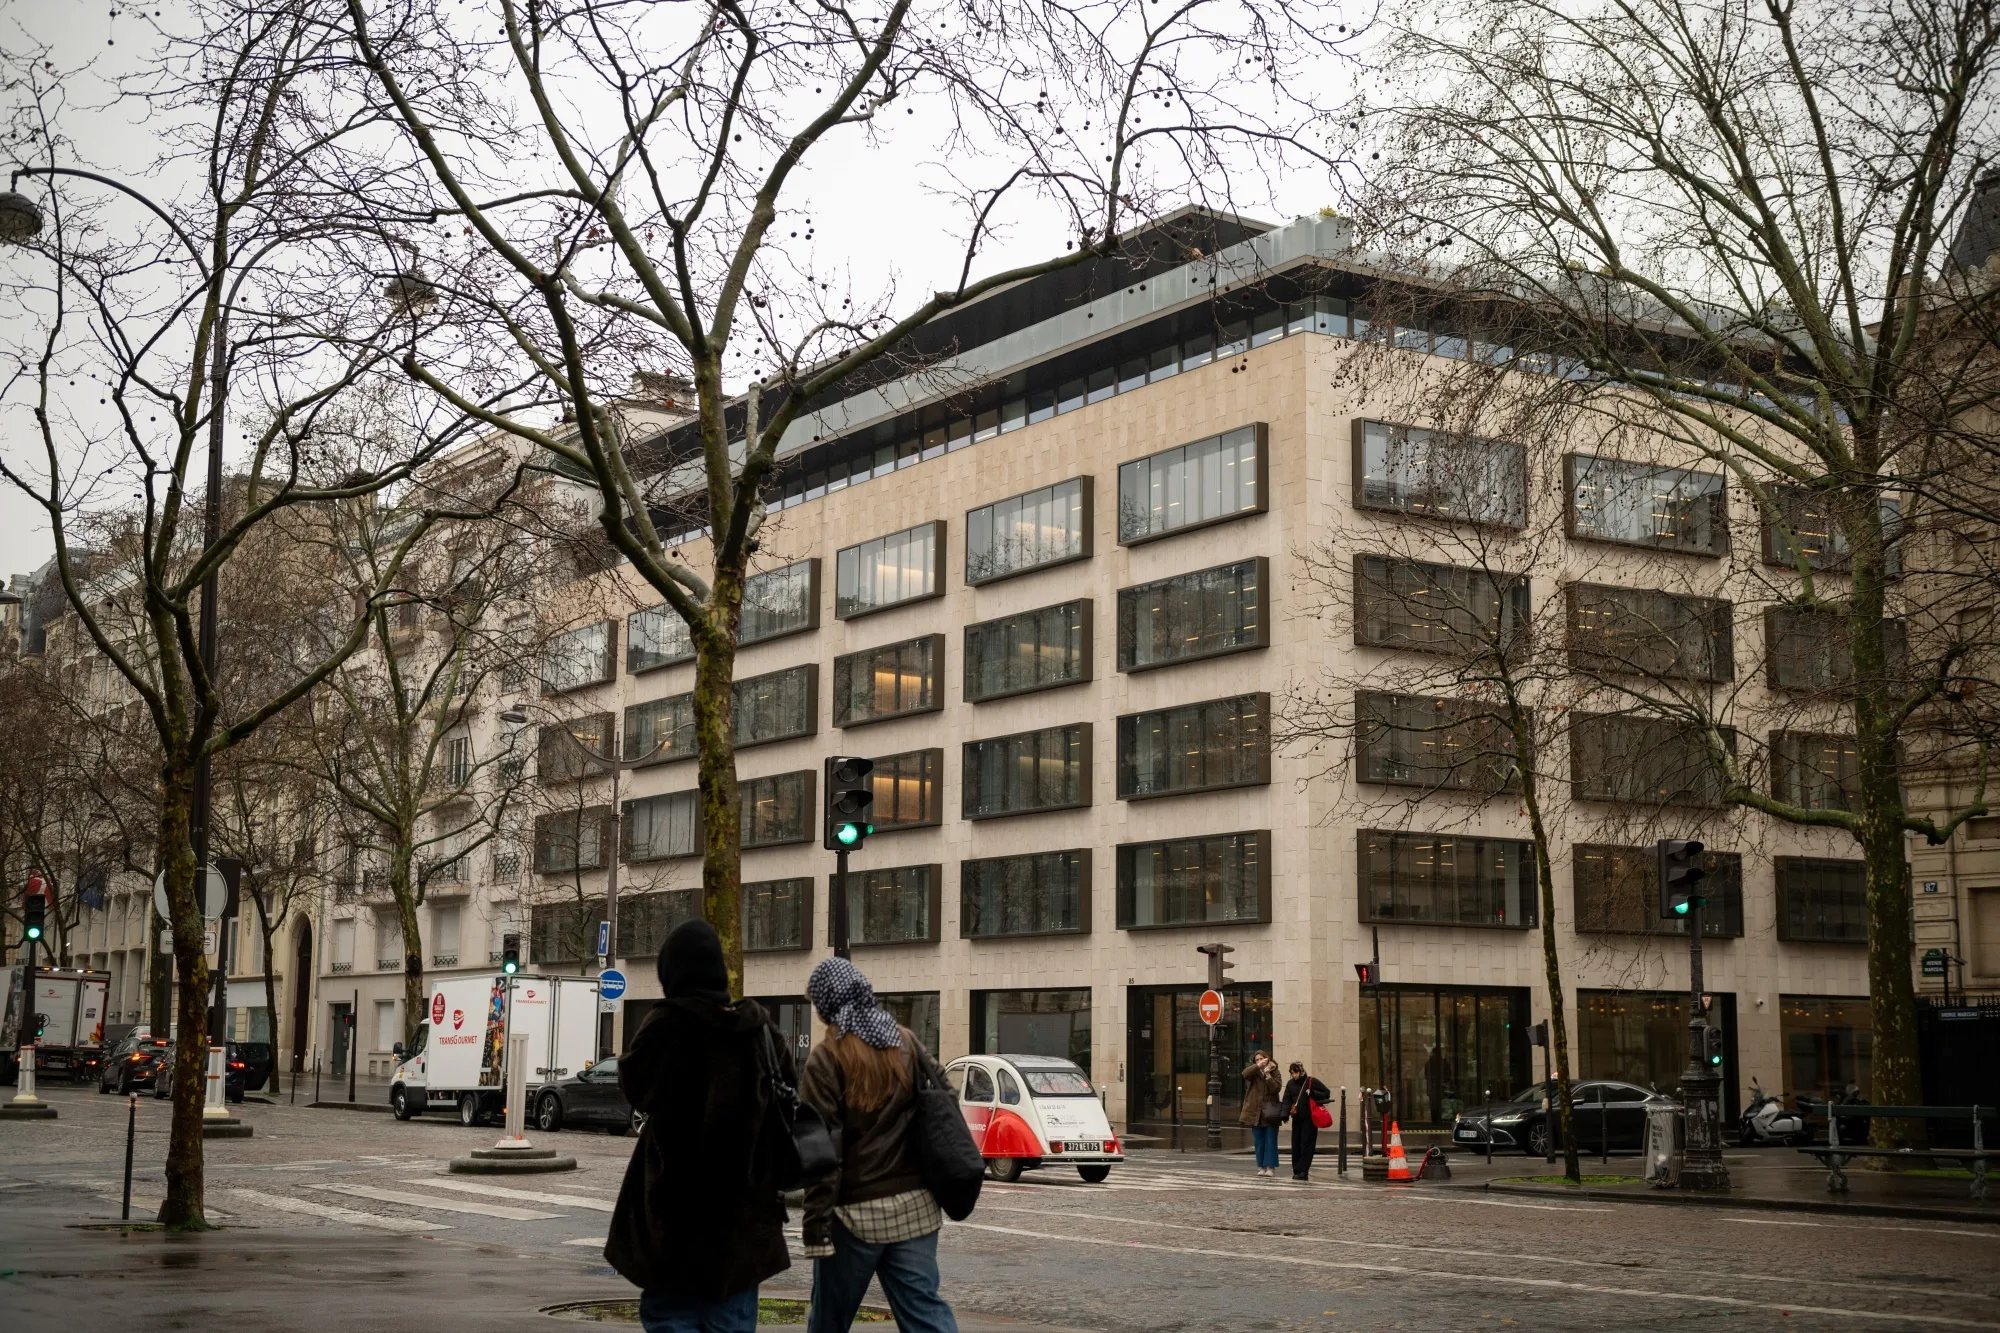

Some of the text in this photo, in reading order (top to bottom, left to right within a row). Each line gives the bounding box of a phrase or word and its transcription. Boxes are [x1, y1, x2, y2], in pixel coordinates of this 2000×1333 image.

[1925, 882, 1936, 891] 87
[601, 929, 606, 949] P
[439, 1034, 477, 1045] TRANSGOURMET
[798, 1034, 810, 1048] 83
[967, 1123, 986, 1131] HENTIC
